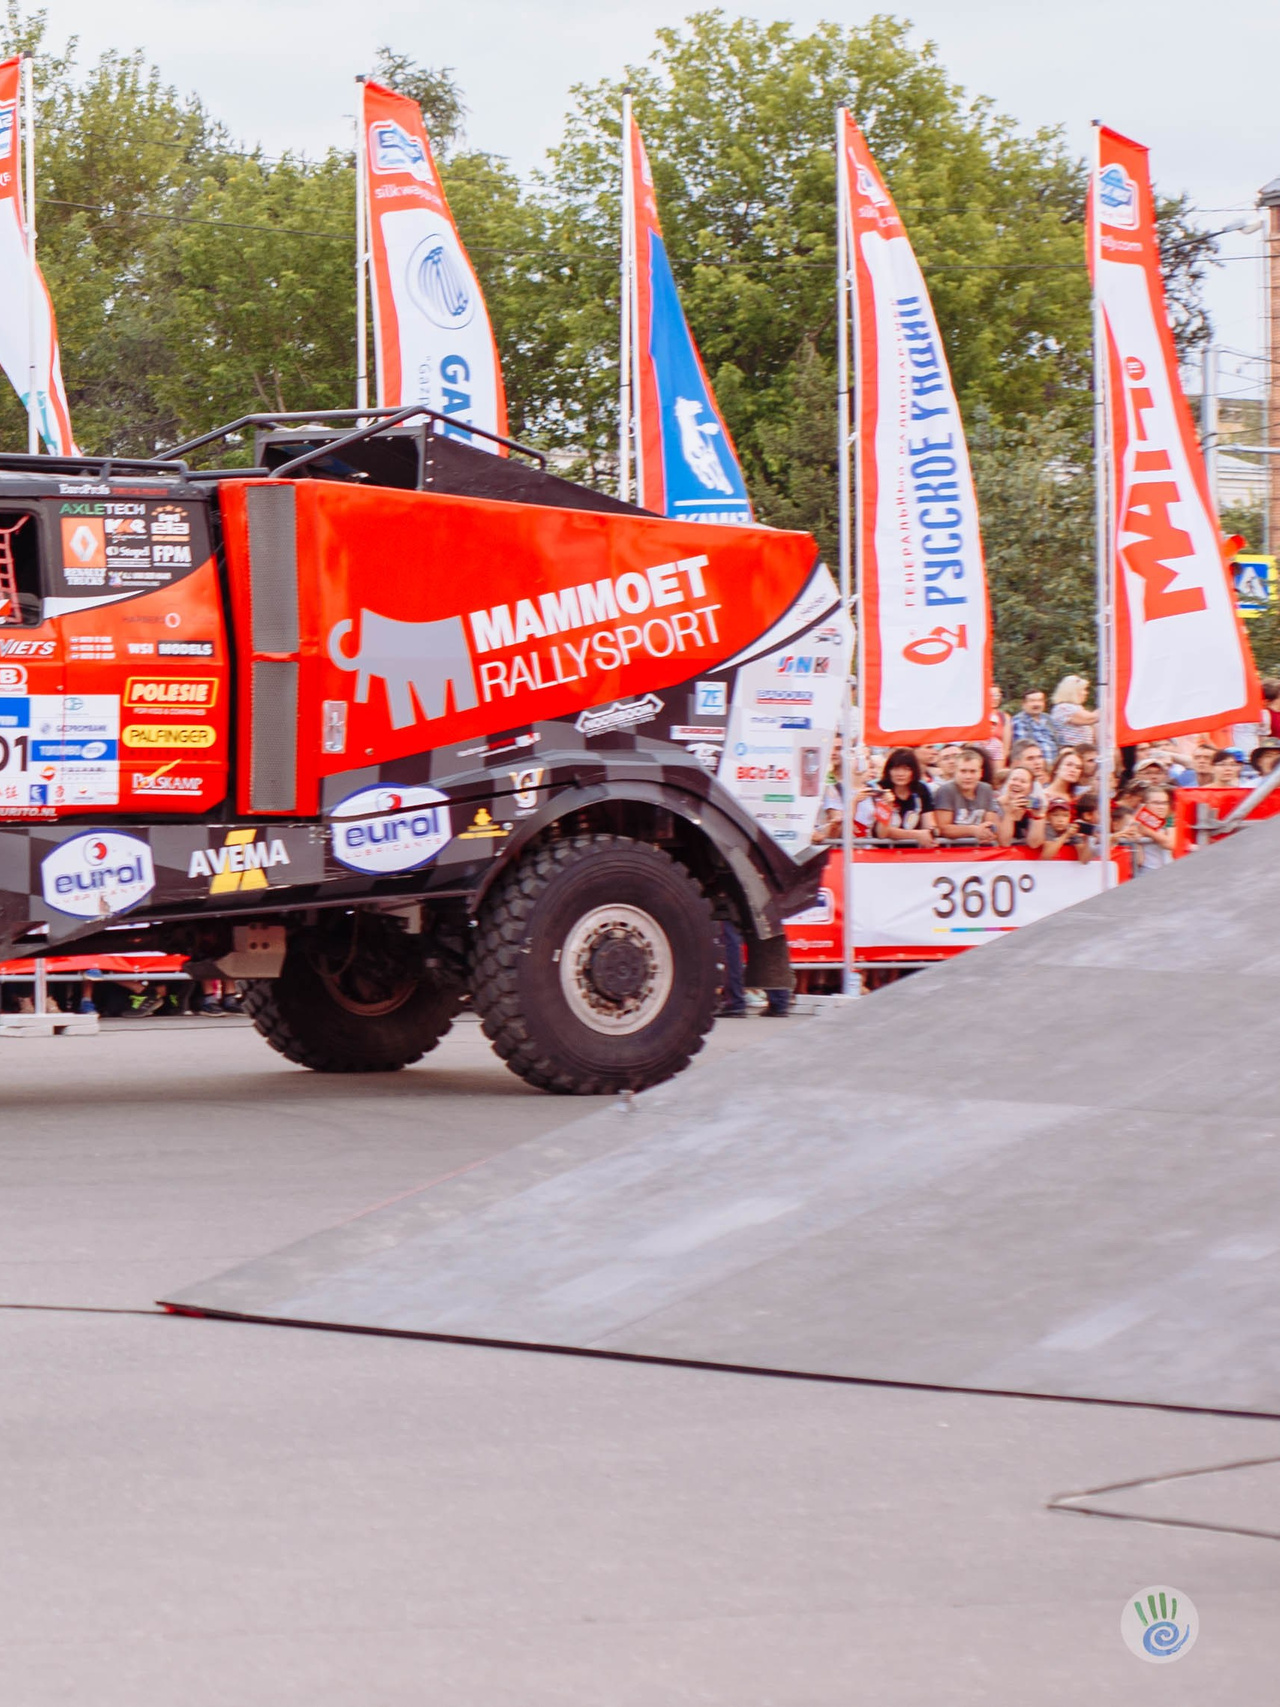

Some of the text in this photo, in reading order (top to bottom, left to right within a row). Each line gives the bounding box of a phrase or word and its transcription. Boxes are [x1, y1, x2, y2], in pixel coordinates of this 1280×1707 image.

[59, 503, 147, 515] AXLETECH
[908, 431, 969, 607] РУССКОЕ
[469, 554, 710, 654] MAMMOET
[158, 643, 213, 656] MODELS
[478, 604, 722, 702] RALLYSPORT
[131, 683, 210, 702] POLESIE
[129, 729, 209, 744] PALFINGER
[345, 807, 440, 847] eurol
[54, 854, 144, 895] eurol
[187, 839, 291, 879] AVEMA
[932, 874, 1035, 919] 360°
